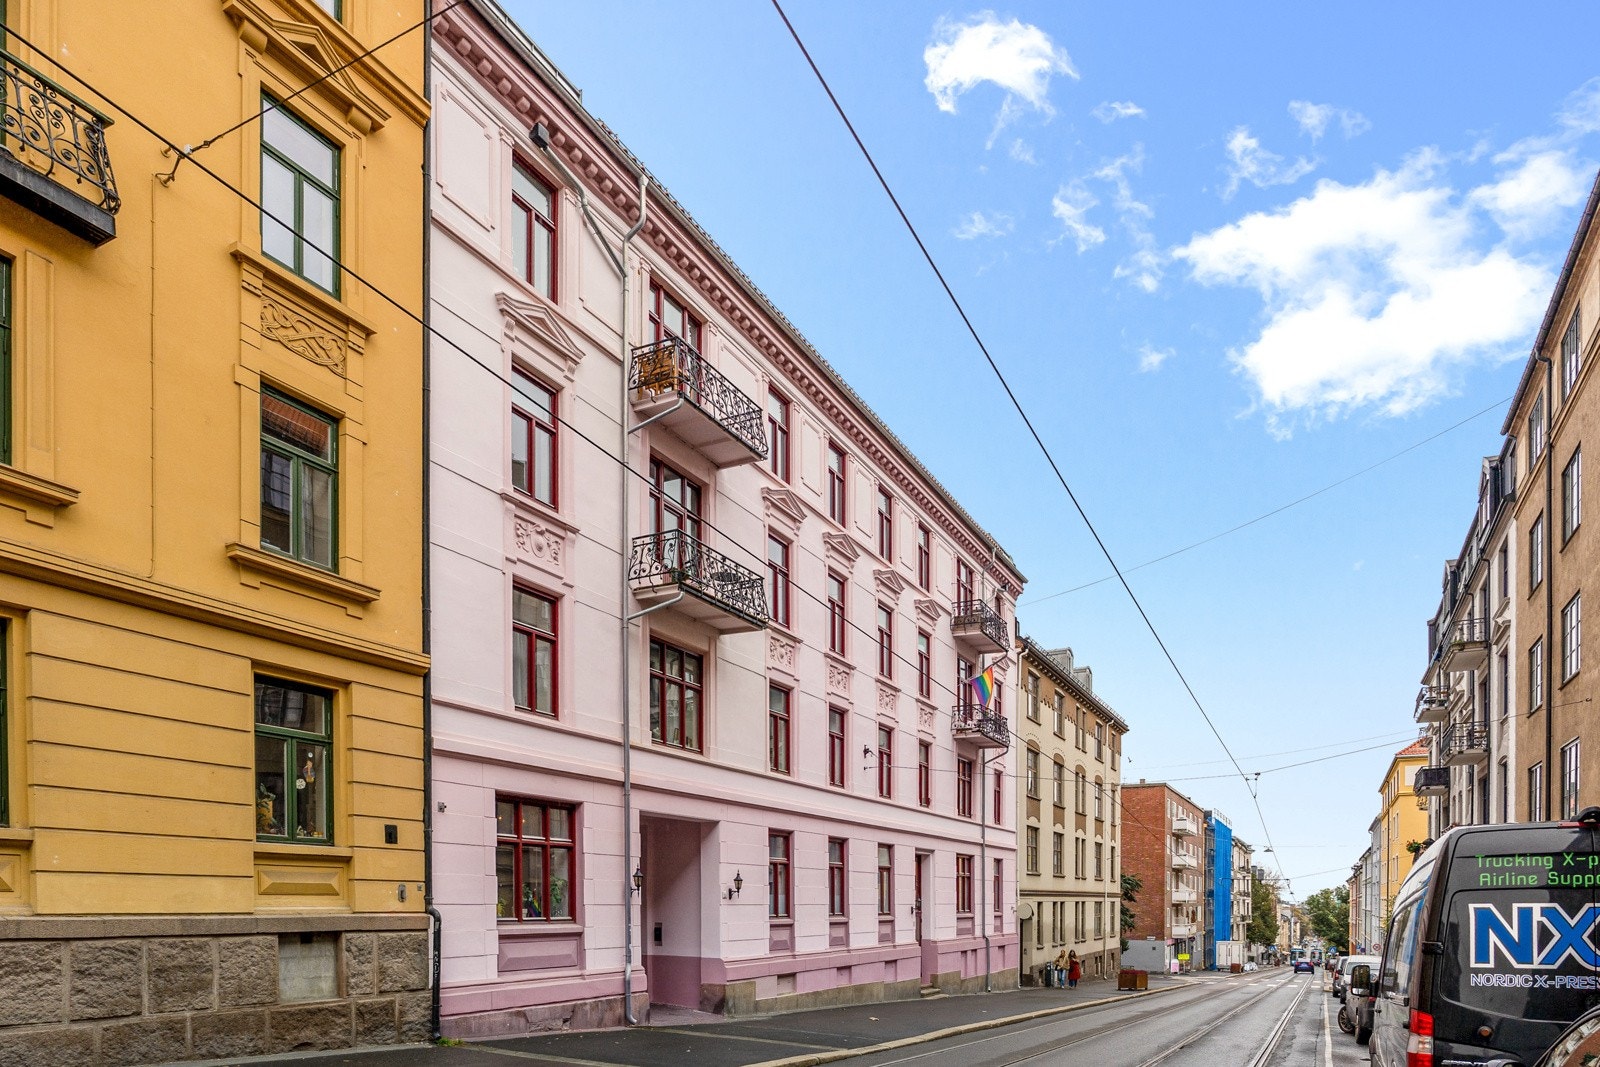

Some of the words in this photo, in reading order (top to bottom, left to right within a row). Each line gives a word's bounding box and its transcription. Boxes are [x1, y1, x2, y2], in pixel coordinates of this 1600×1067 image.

[1475, 853, 1554, 869] Trucking
[1479, 872, 1538, 886] Airline
[1470, 973, 1533, 987] NORDIC
